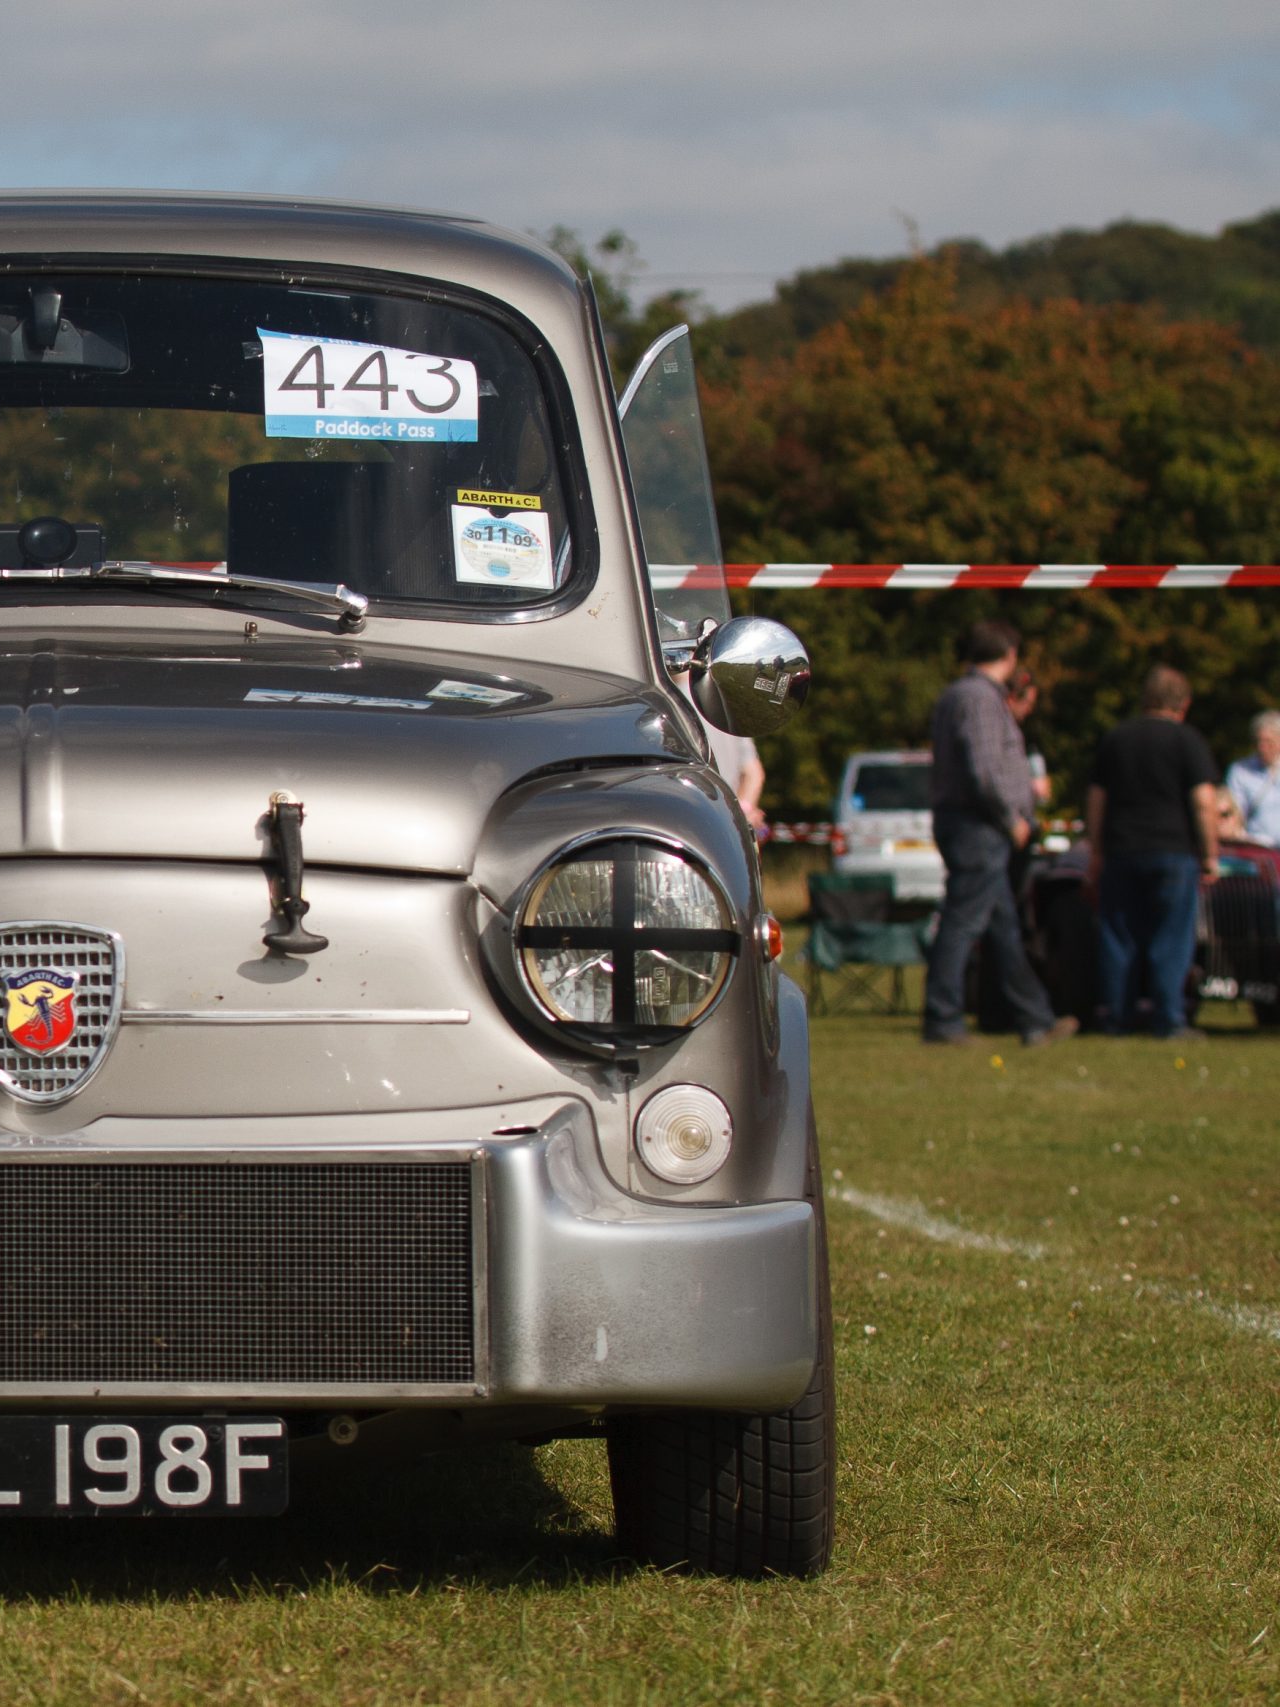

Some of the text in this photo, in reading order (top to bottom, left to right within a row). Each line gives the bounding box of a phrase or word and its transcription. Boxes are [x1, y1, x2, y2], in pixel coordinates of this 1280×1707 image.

[277, 345, 462, 414] 443
[315, 419, 436, 438] Paddock Pass
[461, 492, 514, 505] ABARTH
[466, 528, 482, 541] 30
[483, 525, 508, 544] 11
[513, 534, 533, 548] 09
[54, 1422, 283, 1506] 198F
